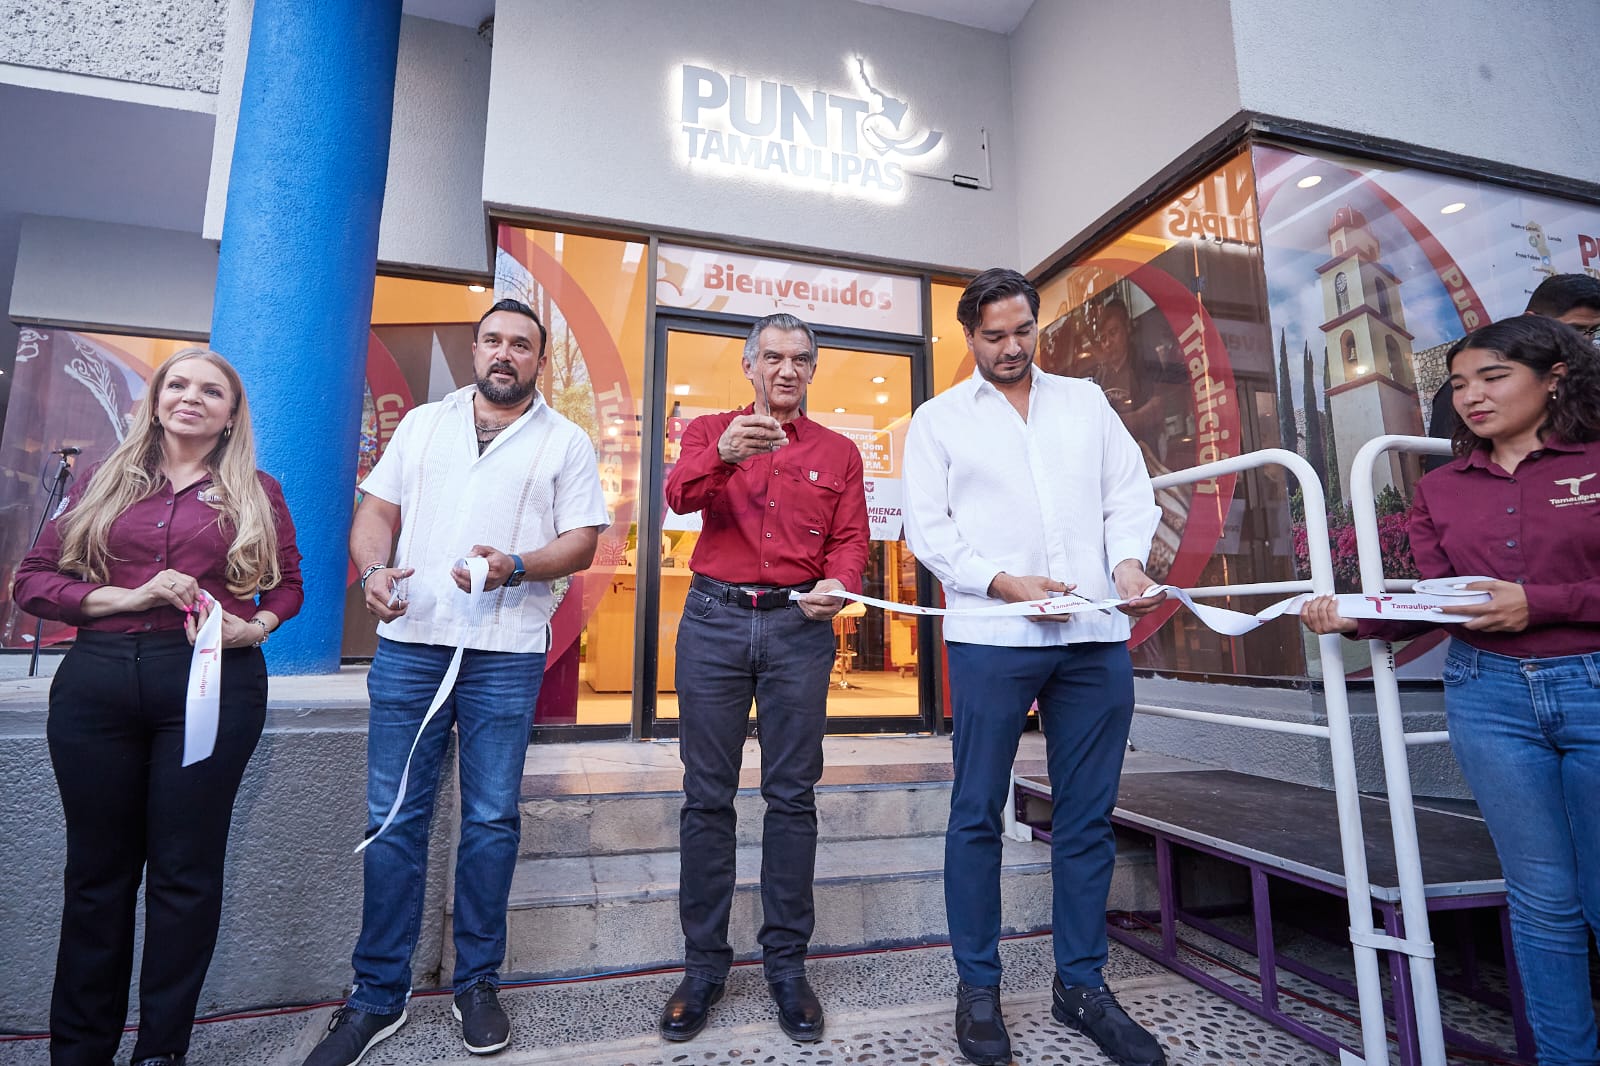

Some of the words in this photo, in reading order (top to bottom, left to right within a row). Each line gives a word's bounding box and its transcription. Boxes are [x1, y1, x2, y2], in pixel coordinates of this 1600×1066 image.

[682, 126, 903, 192] TAMAULIPAS
[703, 263, 893, 311] Bienvenidos
[1441, 266, 1480, 332] Pue
[843, 431, 878, 441] Horario
[863, 442, 884, 451] Dom
[868, 506, 902, 517] MIENZA
